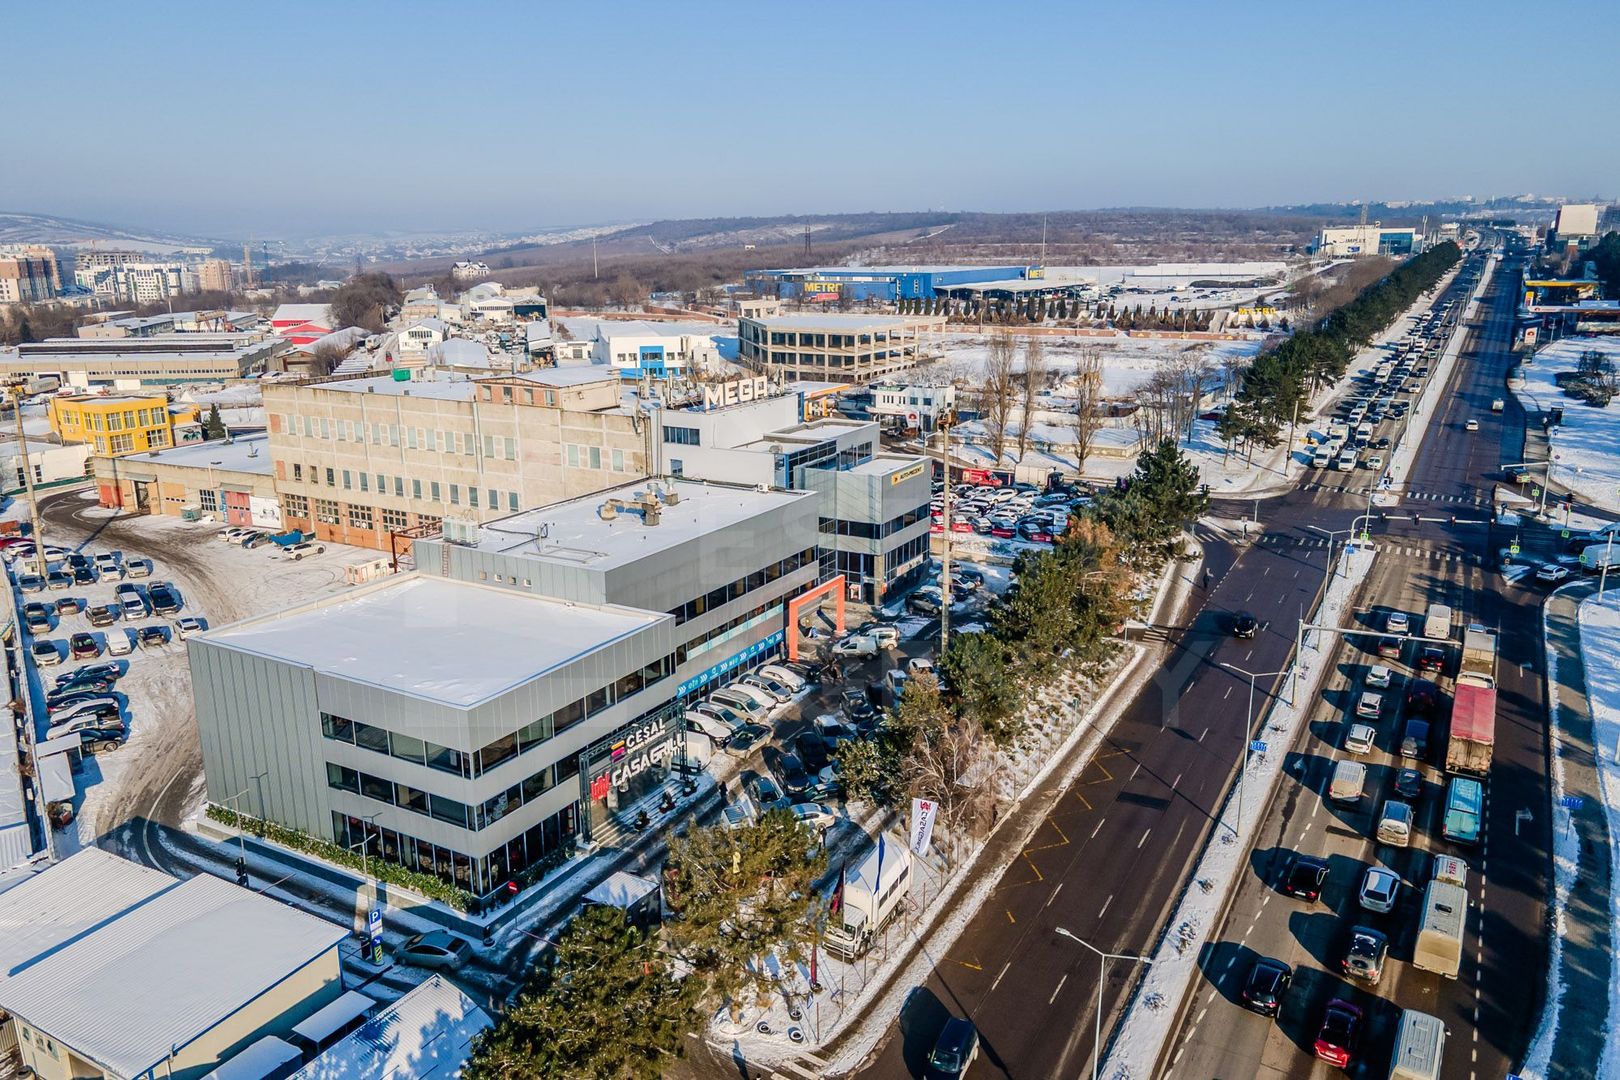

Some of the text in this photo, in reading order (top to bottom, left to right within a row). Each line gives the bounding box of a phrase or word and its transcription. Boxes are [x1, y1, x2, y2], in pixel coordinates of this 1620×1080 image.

[705, 375, 768, 411] MEGA
[626, 718, 666, 747] CESAL
[372, 911, 379, 922] P
